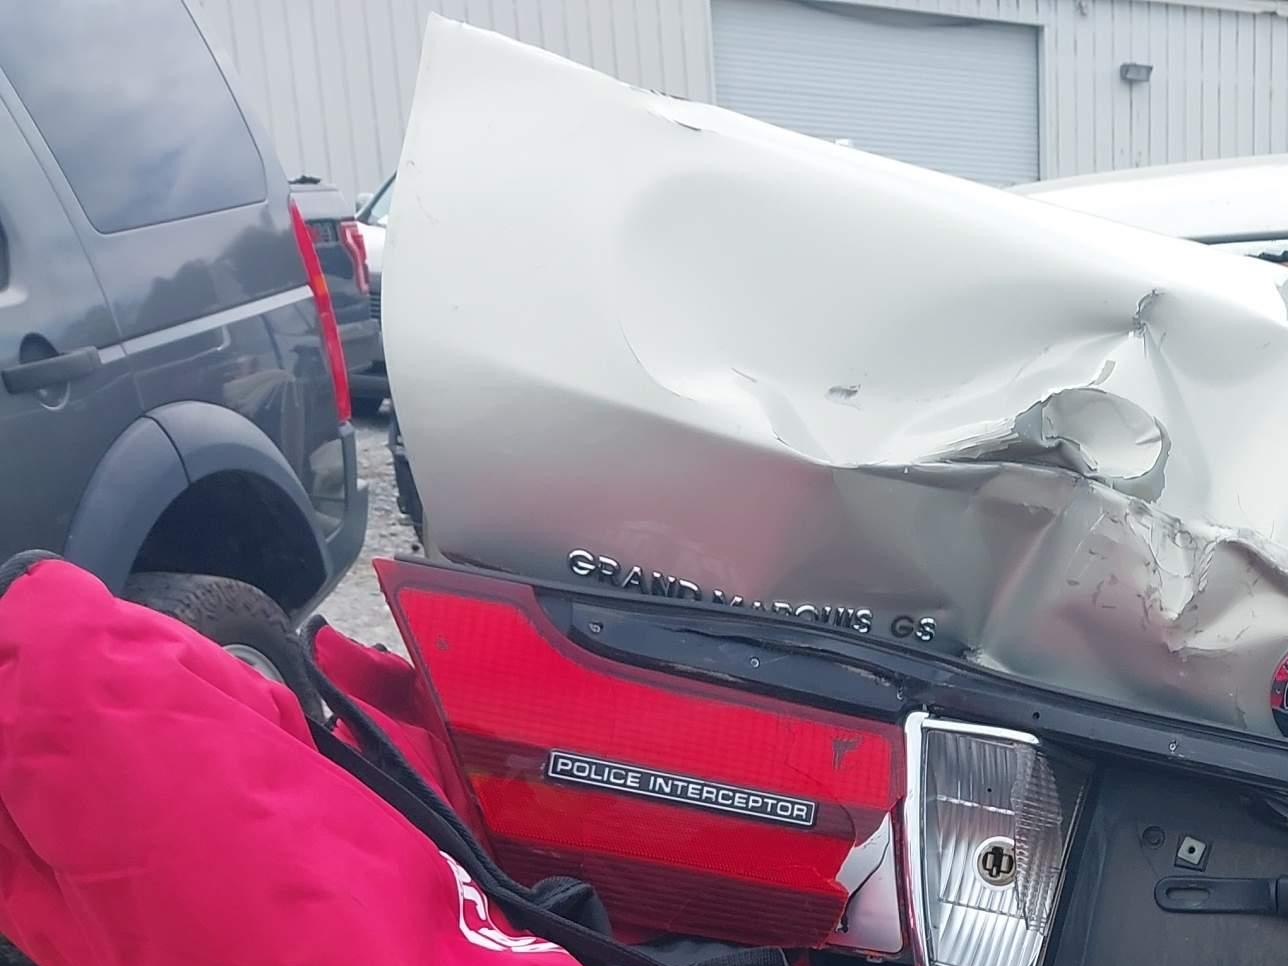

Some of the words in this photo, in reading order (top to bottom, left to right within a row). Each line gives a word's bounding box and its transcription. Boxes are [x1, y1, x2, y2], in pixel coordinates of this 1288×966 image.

[568, 548, 702, 601] GRAND
[890, 614, 938, 642] GS
[556, 757, 640, 787] POLICE
[649, 775, 808, 820] INTERCEPTOR
